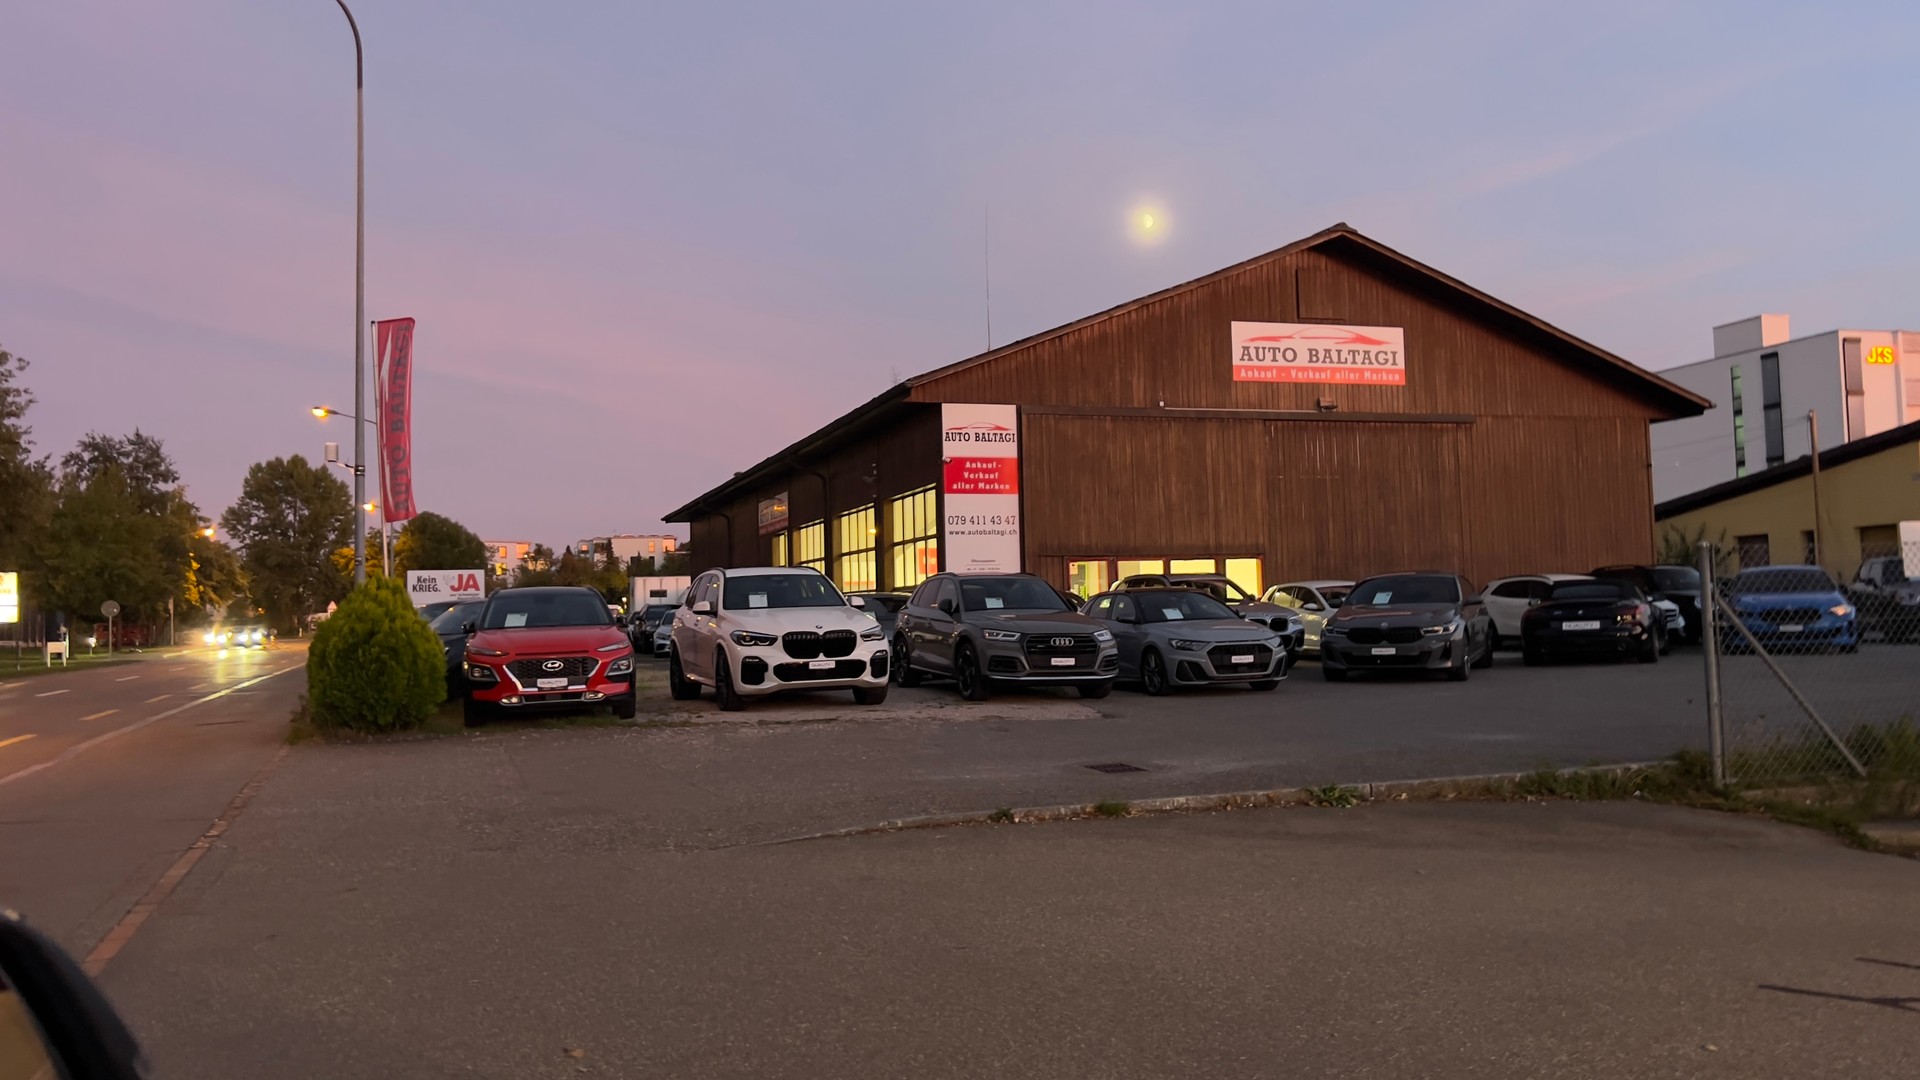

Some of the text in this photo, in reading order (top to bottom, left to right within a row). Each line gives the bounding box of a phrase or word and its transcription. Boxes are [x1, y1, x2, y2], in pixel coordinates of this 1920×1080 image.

[1239, 346, 1399, 366] AUTO BALTAGI
[1866, 346, 1894, 364] JKS
[1240, 368, 1277, 379] Ankauf
[1291, 369, 1331, 379] Verkauf
[1335, 370, 1360, 380] aller
[1364, 371, 1400, 381] Marken
[944, 432, 1016, 443] AUTO BALTAGI
[963, 471, 999, 479] Verkauf
[952, 482, 1010, 490] aller Marken
[948, 515, 1016, 525] 079 411 43 47
[949, 528, 1018, 537] www.autobaltagi.ch
[416, 575, 437, 584] Kein
[449, 573, 481, 593] JA
[412, 583, 442, 593] KRIEG.
